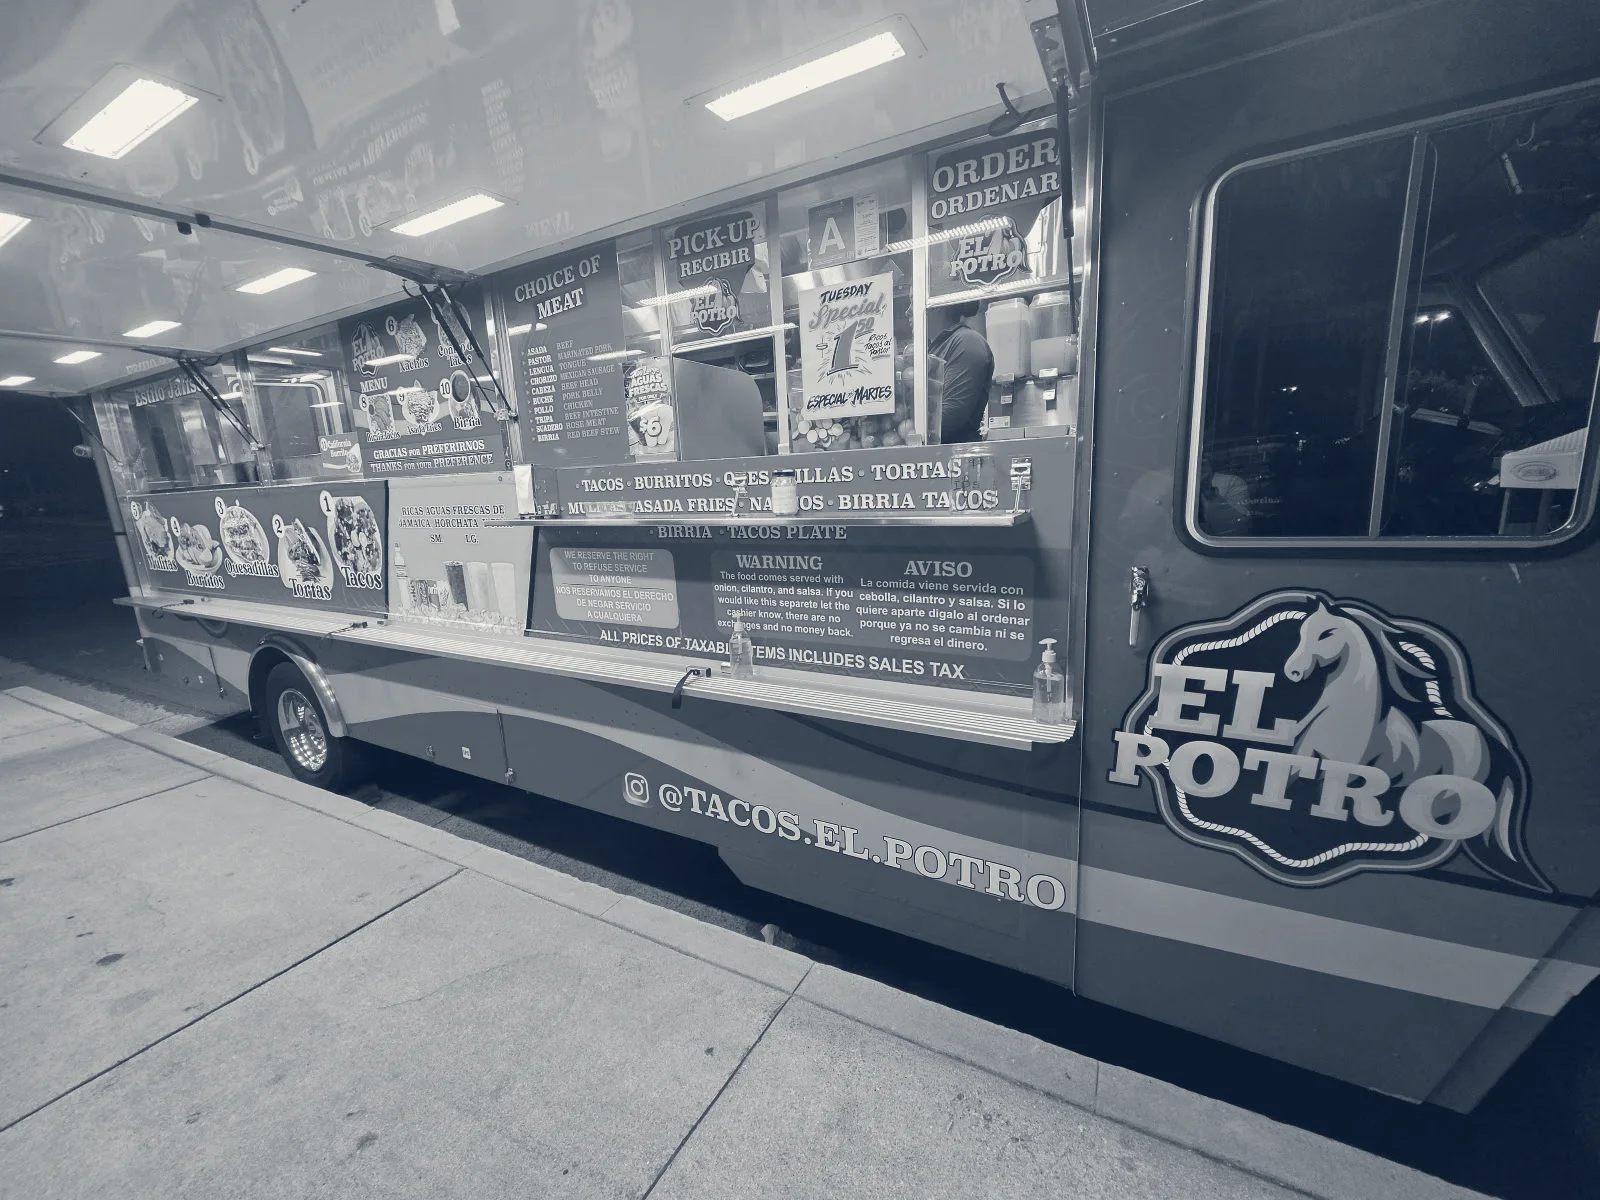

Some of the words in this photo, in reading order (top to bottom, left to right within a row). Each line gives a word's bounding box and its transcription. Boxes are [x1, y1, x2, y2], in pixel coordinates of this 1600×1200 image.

[932, 137, 1059, 193] ORDER
[931, 171, 1060, 220] ORDENAR
[668, 217, 760, 260] PICK-UP
[819, 217, 846, 255] A
[958, 236, 988, 259] EL
[680, 247, 751, 278] RECIBIR
[950, 250, 1023, 277] POTRO
[514, 265, 575, 303] CHOICE
[578, 254, 601, 278] OF
[820, 281, 874, 305] TUESDAY
[536, 287, 584, 319] MEAT
[694, 296, 714, 310] EL
[690, 305, 737, 323] POTRO
[808, 294, 885, 331] Special
[527, 345, 548, 357] ASADA
[556, 340, 574, 350] BEEF
[528, 355, 552, 366] PASTOR
[594, 343, 613, 355] PORK
[400, 359, 429, 373] Nachos
[529, 365, 555, 375] LENGUA
[559, 359, 587, 370] TONGUE
[530, 375, 558, 386] CHORIZO
[560, 369, 587, 381] MEXICAN
[587, 365, 616, 376] SAUSAGE
[561, 380, 579, 390] BEEF
[579, 378, 599, 388] HEAD
[630, 373, 663, 388] AGUAS
[360, 377, 388, 393] MENU
[441, 381, 451, 395] 10
[562, 390, 581, 400] PORK
[581, 388, 603, 399] BELLY
[628, 382, 668, 398] FRESCAS
[135, 387, 165, 408] Estilo
[806, 391, 849, 411] ESPECIAL
[852, 384, 893, 406] MARTES
[534, 405, 554, 414] POLLO
[563, 400, 594, 411] CHICKEN
[565, 411, 582, 421] BEEF
[453, 416, 481, 429] Birria
[566, 420, 585, 429] ROSE
[585, 418, 607, 428] MEAT
[639, 414, 663, 438] $6
[567, 430, 581, 439] RED
[581, 428, 600, 438] BEEF
[600, 426, 621, 436] STEW
[373, 448, 407, 460] GRACIAS
[408, 448, 420, 456] POR
[422, 440, 485, 455] PREFERIRNOS
[371, 462, 403, 473] THANKS
[417, 461, 432, 469] YOUR
[433, 454, 494, 468] PREFERENCE
[581, 477, 624, 492] TACOS
[634, 473, 713, 490] BURRITOS
[871, 458, 962, 481] TORTAS
[401, 505, 424, 516] RICAS
[425, 505, 451, 515] AGUAS
[452, 505, 491, 515] FRESCAS
[492, 504, 505, 515] DE
[634, 498, 685, 514] ASADA
[687, 497, 735, 513] FRIES
[838, 493, 915, 510] BIRRIA
[922, 489, 999, 512] TACOS
[434, 518, 479, 528] HORCHATA
[658, 526, 712, 539] BIRRIA
[726, 525, 781, 539] TACOS
[787, 525, 847, 540] PLATE
[564, 551, 576, 559] WE
[577, 551, 611, 560] RESERVE
[613, 552, 628, 560] THE
[629, 552, 654, 561] RIGHT
[736, 554, 823, 570] WARNING
[225, 557, 279, 578] Quesadillas
[573, 562, 582, 571] TO
[584, 563, 613, 572] REFUSE
[614, 564, 648, 573] SERVICE
[904, 561, 973, 578] AVISO
[186, 569, 225, 589] Burritos
[341, 566, 383, 590] Tacos
[589, 574, 599, 583] TO
[600, 575, 632, 584] ANYONE
[720, 571, 735, 580] The
[737, 571, 756, 581] food
[758, 574, 787, 582] comes
[789, 574, 821, 583] served
[824, 575, 844, 584] with
[289, 577, 332, 600] Tortas
[556, 586, 571, 595] NOS
[572, 587, 621, 598] RESERVAMOS
[622, 590, 633, 599] EL
[634, 590, 674, 601] DERECHO
[714, 584, 739, 593] onion,
[741, 585, 776, 595] cilantro,
[778, 586, 795, 595] and
[797, 587, 824, 596] salsa.
[826, 588, 834, 596] If
[835, 590, 854, 600] you
[860, 578, 873, 587] La
[876, 579, 915, 589] comida
[918, 581, 949, 591] viene
[952, 582, 997, 593] servida
[1000, 586, 1024, 596] con
[577, 599, 587, 607] DE
[588, 599, 614, 609] NEGAR
[615, 601, 651, 612] SERVICIO
[718, 596, 742, 605] would
[744, 597, 759, 606] like
[761, 597, 777, 607] this
[779, 600, 818, 610] separete
[820, 601, 833, 610] let
[834, 601, 850, 611] the
[859, 593, 900, 604] cebolla,
[903, 594, 946, 605] cilantro
[949, 597, 956, 607] y
[959, 597, 994, 608] salsa.
[997, 599, 1010, 609] Si
[1013, 600, 1026, 611] lo
[593, 611, 643, 622] CUALQUIERA
[758, 609, 784, 620] know,
[785, 612, 809, 621] there
[811, 614, 826, 622] are
[828, 615, 841, 623] no
[856, 606, 888, 616] quiere
[891, 608, 926, 618] aparte
[928, 609, 964, 621] digalo
[967, 612, 978, 621] al
[981, 614, 1031, 626] ordenar
[763, 623, 779, 631] and
[794, 627, 825, 636] money
[827, 627, 854, 638] back.
[860, 619, 897, 631] porque
[899, 622, 912, 632] ya
[915, 623, 930, 631] no
[932, 624, 946, 632] se
[949, 624, 992, 637] cambia
[995, 628, 1007, 638] ni
[1009, 631, 1025, 640] se
[890, 635, 931, 646] regresa
[933, 636, 944, 647] el
[947, 639, 988, 651] dinero.
[600, 630, 620, 642] ALL
[623, 631, 663, 647] PRICES
[666, 636, 681, 649] OF
[789, 649, 865, 669] INCLUDES
[869, 656, 925, 675] SALES
[929, 662, 965, 680] TAX
[1149, 662, 1299, 746] EL
[1108, 730, 1497, 840] POTRO
[658, 783, 1066, 911] @TACOS.EL.POTRO
